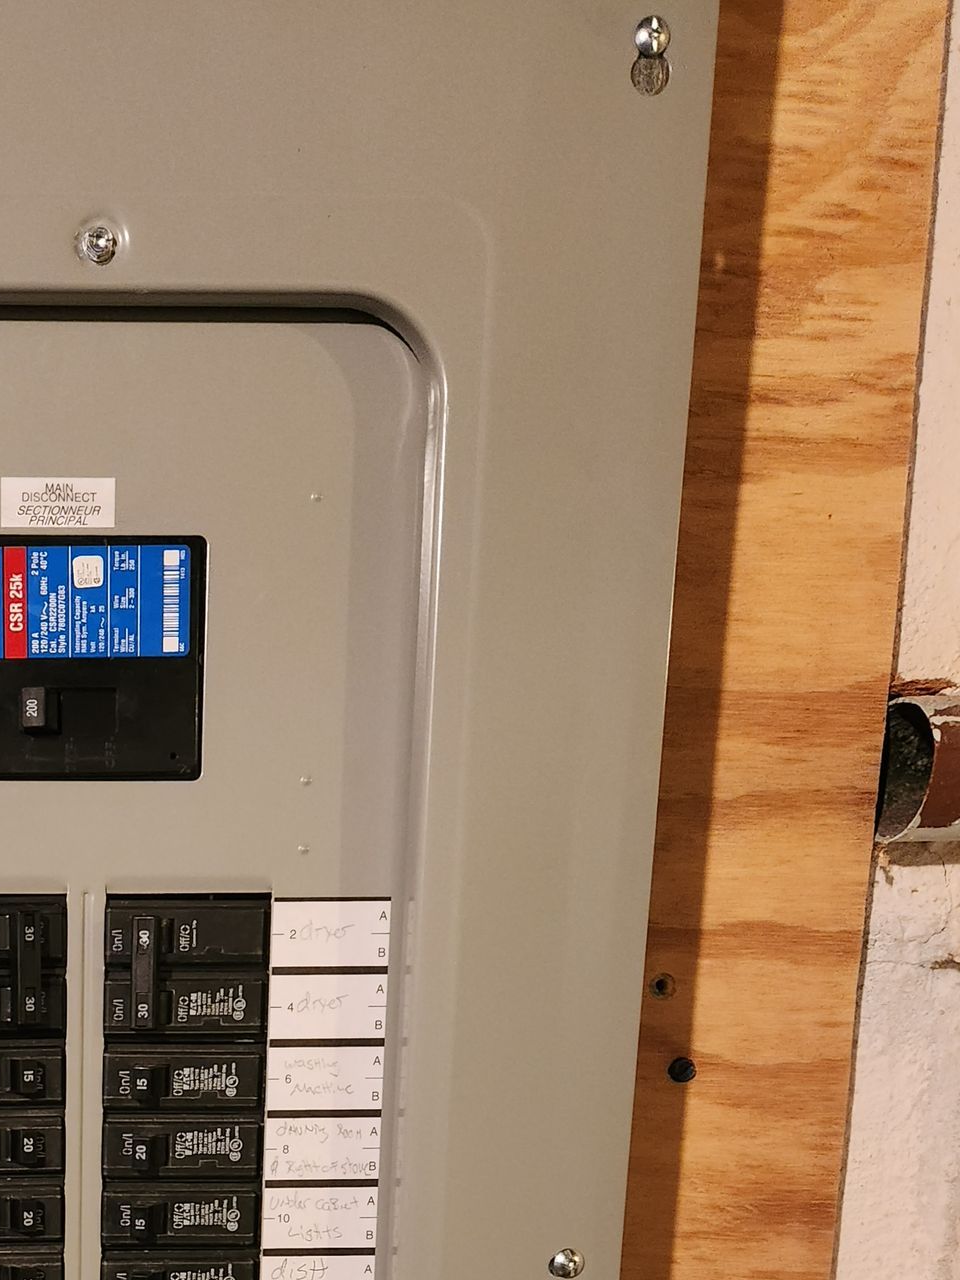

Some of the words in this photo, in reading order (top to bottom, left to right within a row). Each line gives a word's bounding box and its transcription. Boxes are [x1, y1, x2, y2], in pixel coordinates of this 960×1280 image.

[45, 483, 73, 492] MAIN
[22, 492, 96, 502] DISCONNECT
[17, 506, 101, 515] SECTIONNEUR
[29, 516, 88, 525] PRINCIPAL
[31, 552, 39, 569] Pole
[10, 574, 23, 598] 25k
[10, 603, 23, 631] CSR
[26, 699, 37, 717] 200
[25, 926, 35, 941] 30
[138, 930, 150, 948] 30
[289, 929, 297, 940] 2
[25, 996, 35, 1012] 30
[286, 1002, 295, 1012] 4
[137, 1003, 149, 1019] 30
[23, 1070, 34, 1082] 15
[284, 1074, 292, 1085] 6
[136, 1078, 148, 1090] 15
[23, 1137, 34, 1153] 20
[282, 1144, 290, 1155] 8
[135, 1145, 147, 1160] 20
[23, 1211, 34, 1227] 20
[135, 1219, 146, 1230] 15
[278, 1213, 290, 1224] 10
